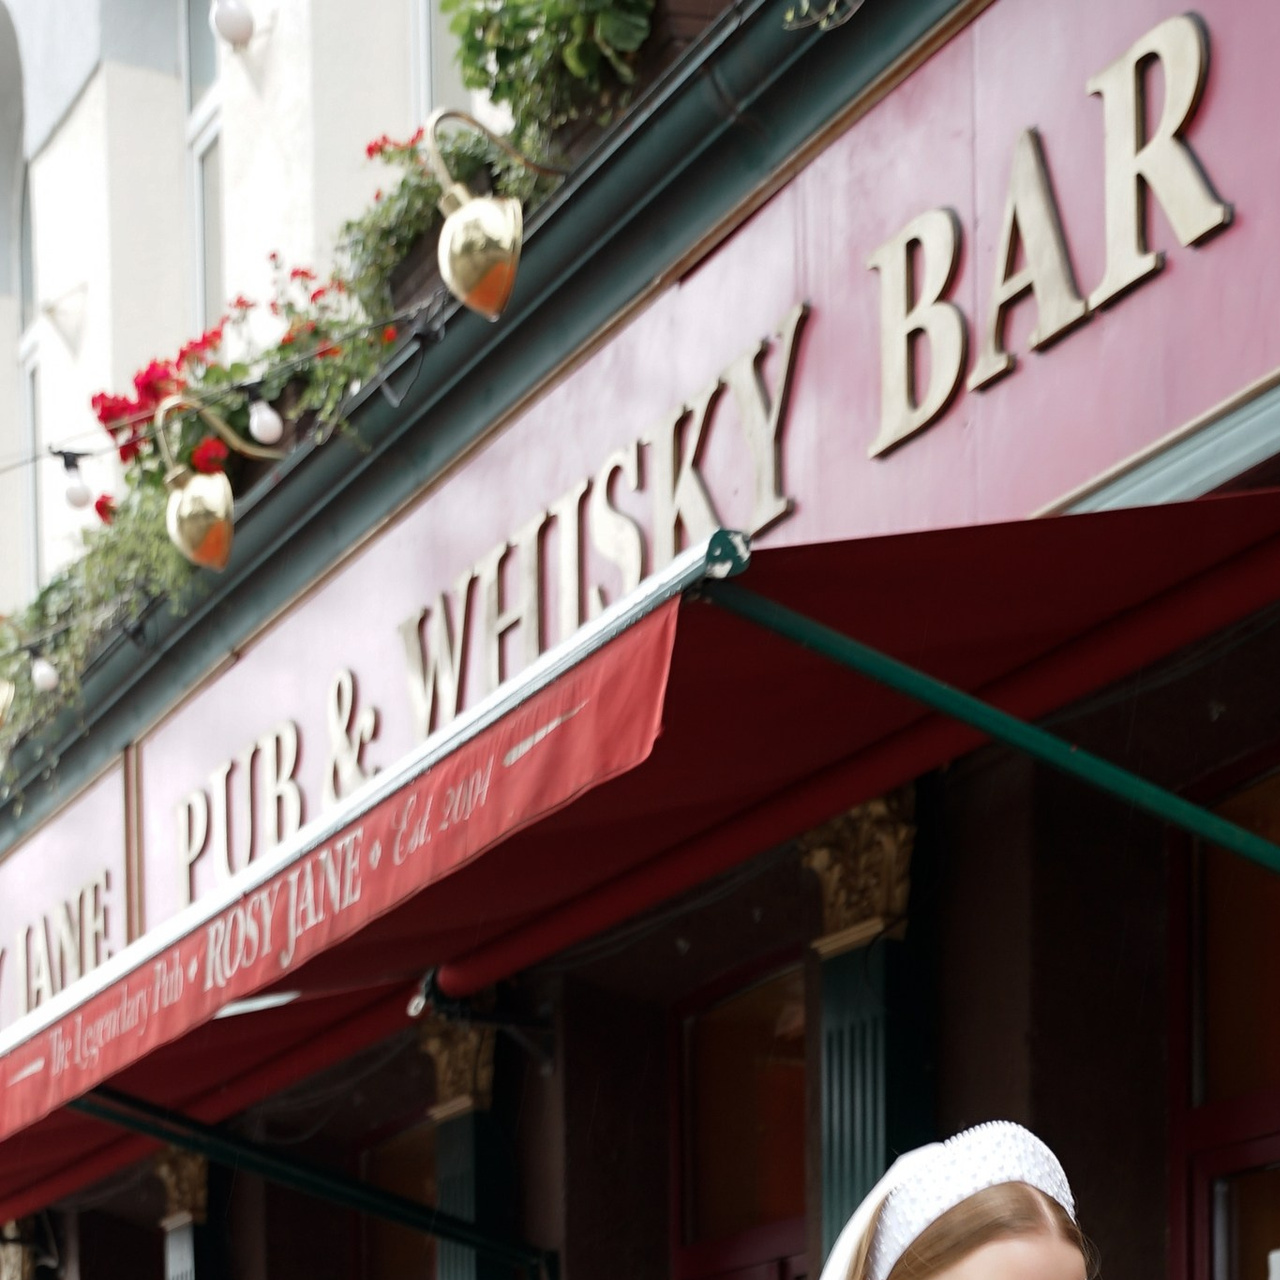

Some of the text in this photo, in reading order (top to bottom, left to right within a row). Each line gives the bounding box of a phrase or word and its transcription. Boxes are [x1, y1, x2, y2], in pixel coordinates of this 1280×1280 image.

[175, 11, 1234, 910] PUB & WHISKY BAR
[51, 1027, 72, 1077] The
[74, 981, 148, 1071] Legendary
[153, 949, 185, 1016] Pub
[203, 880, 283, 991] ROSY
[279, 826, 364, 970] JANE
